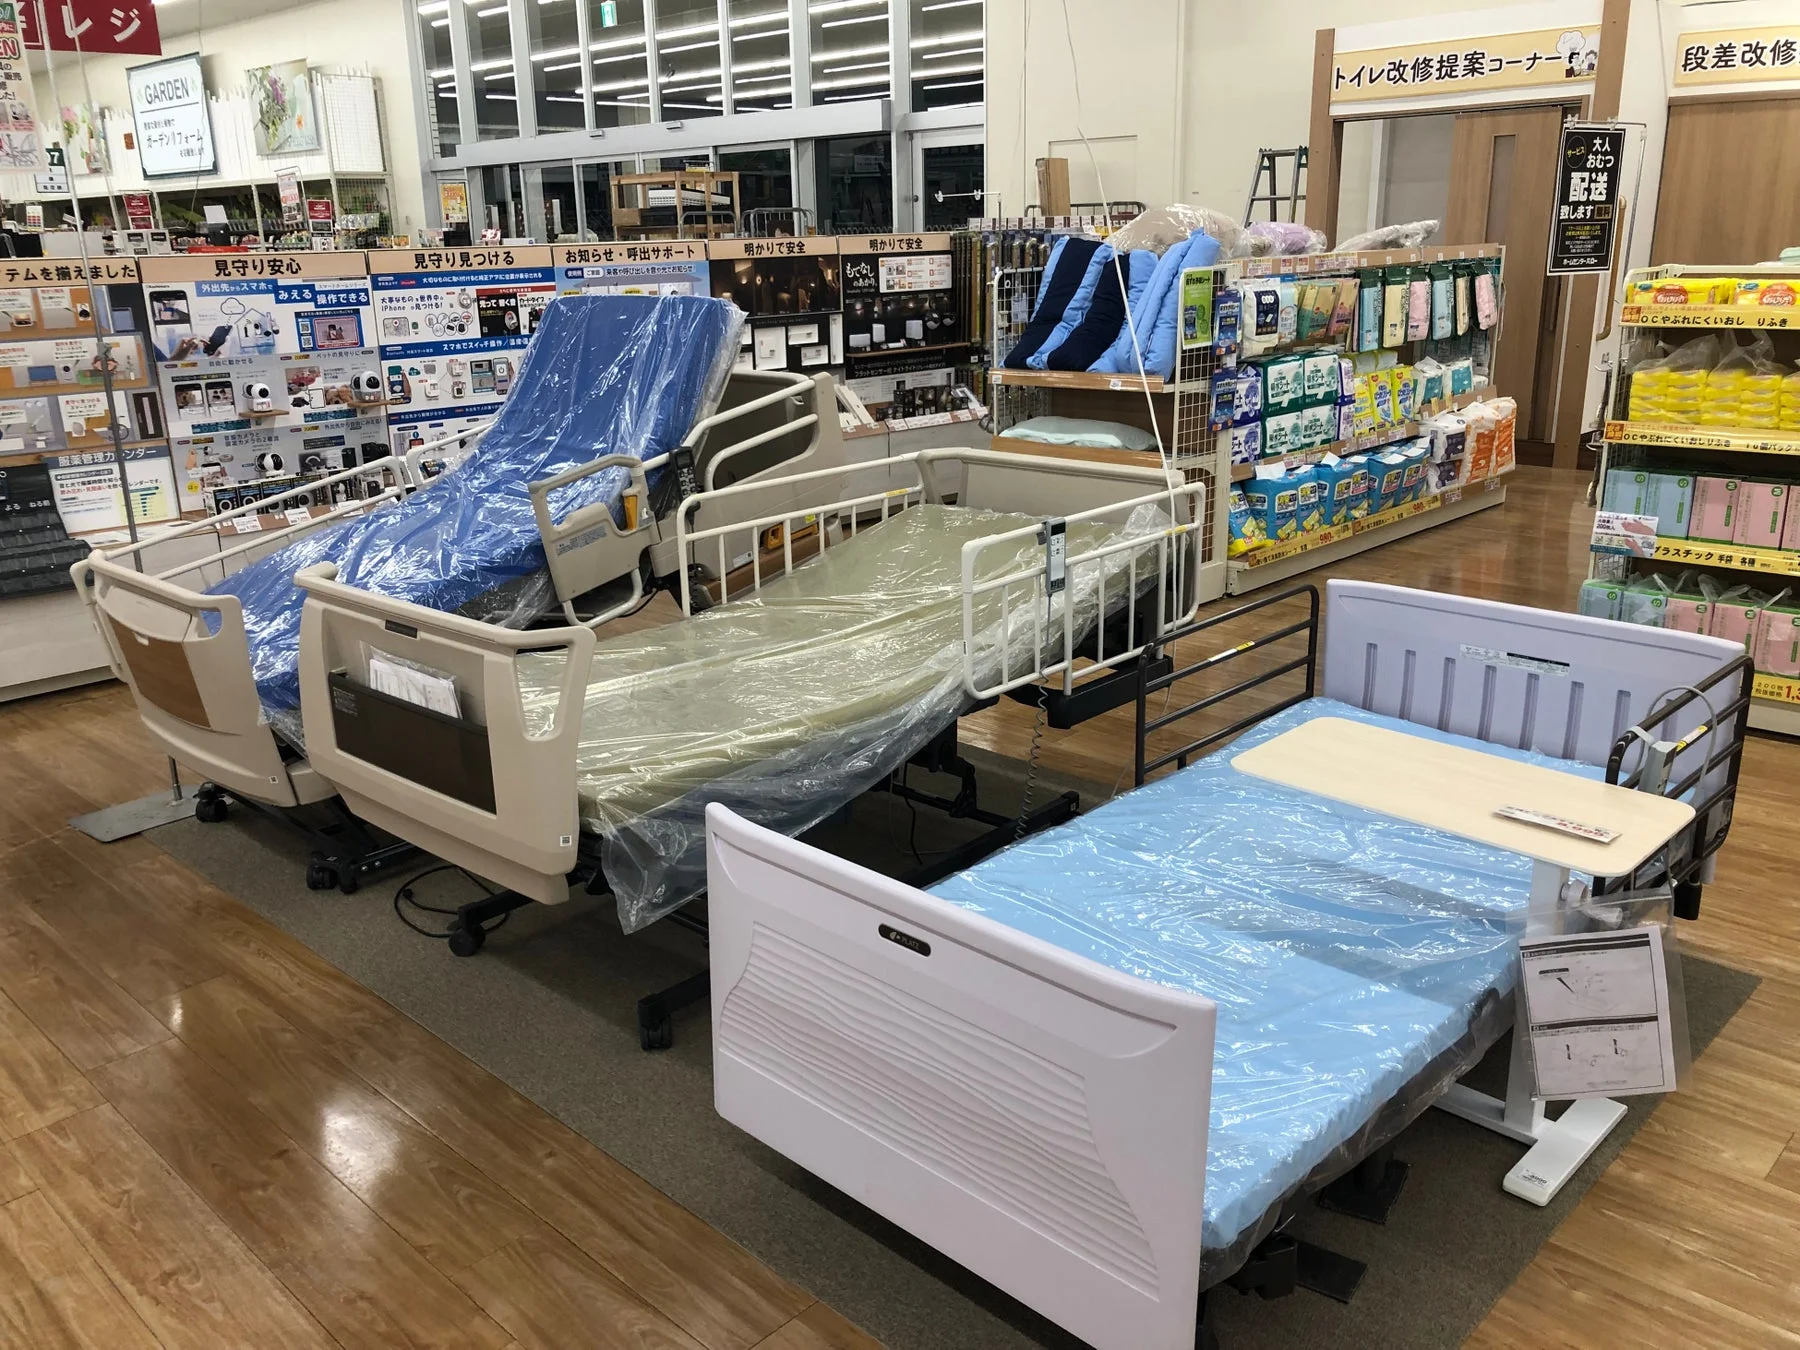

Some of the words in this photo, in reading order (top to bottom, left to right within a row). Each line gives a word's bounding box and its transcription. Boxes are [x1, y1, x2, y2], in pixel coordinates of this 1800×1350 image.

[61, 5, 142, 42] レジ
[1682, 38, 1800, 73] 段差改修
[1334, 50, 1563, 90] トイレ改修提案コーナー
[144, 77, 190, 104] GARDEN
[1566, 146, 1585, 158] サービス
[1592, 136, 1611, 152] 大人
[1586, 153, 1615, 169] おむつ
[1568, 171, 1608, 202] 配送
[1560, 204, 1594, 220] 致します
[744, 241, 806, 256] 明かりで安全
[869, 238, 923, 252] 明かりで安全
[414, 251, 515, 269] 見守り見つける
[565, 245, 696, 264] お知らせ・呼出サポート
[214, 257, 302, 277] 見守り安心
[846, 262, 875, 278] もてなし
[201, 282, 274, 293] 外出先からスマホで
[278, 289, 313, 300] みえる
[316, 292, 369, 304] 操作できる
[1757, 317, 1789, 328] りふき
[58, 448, 157, 467] 服薬管理カンダー
[5, 503, 21, 511] よる
[1717, 554, 1734, 565] 手袋
